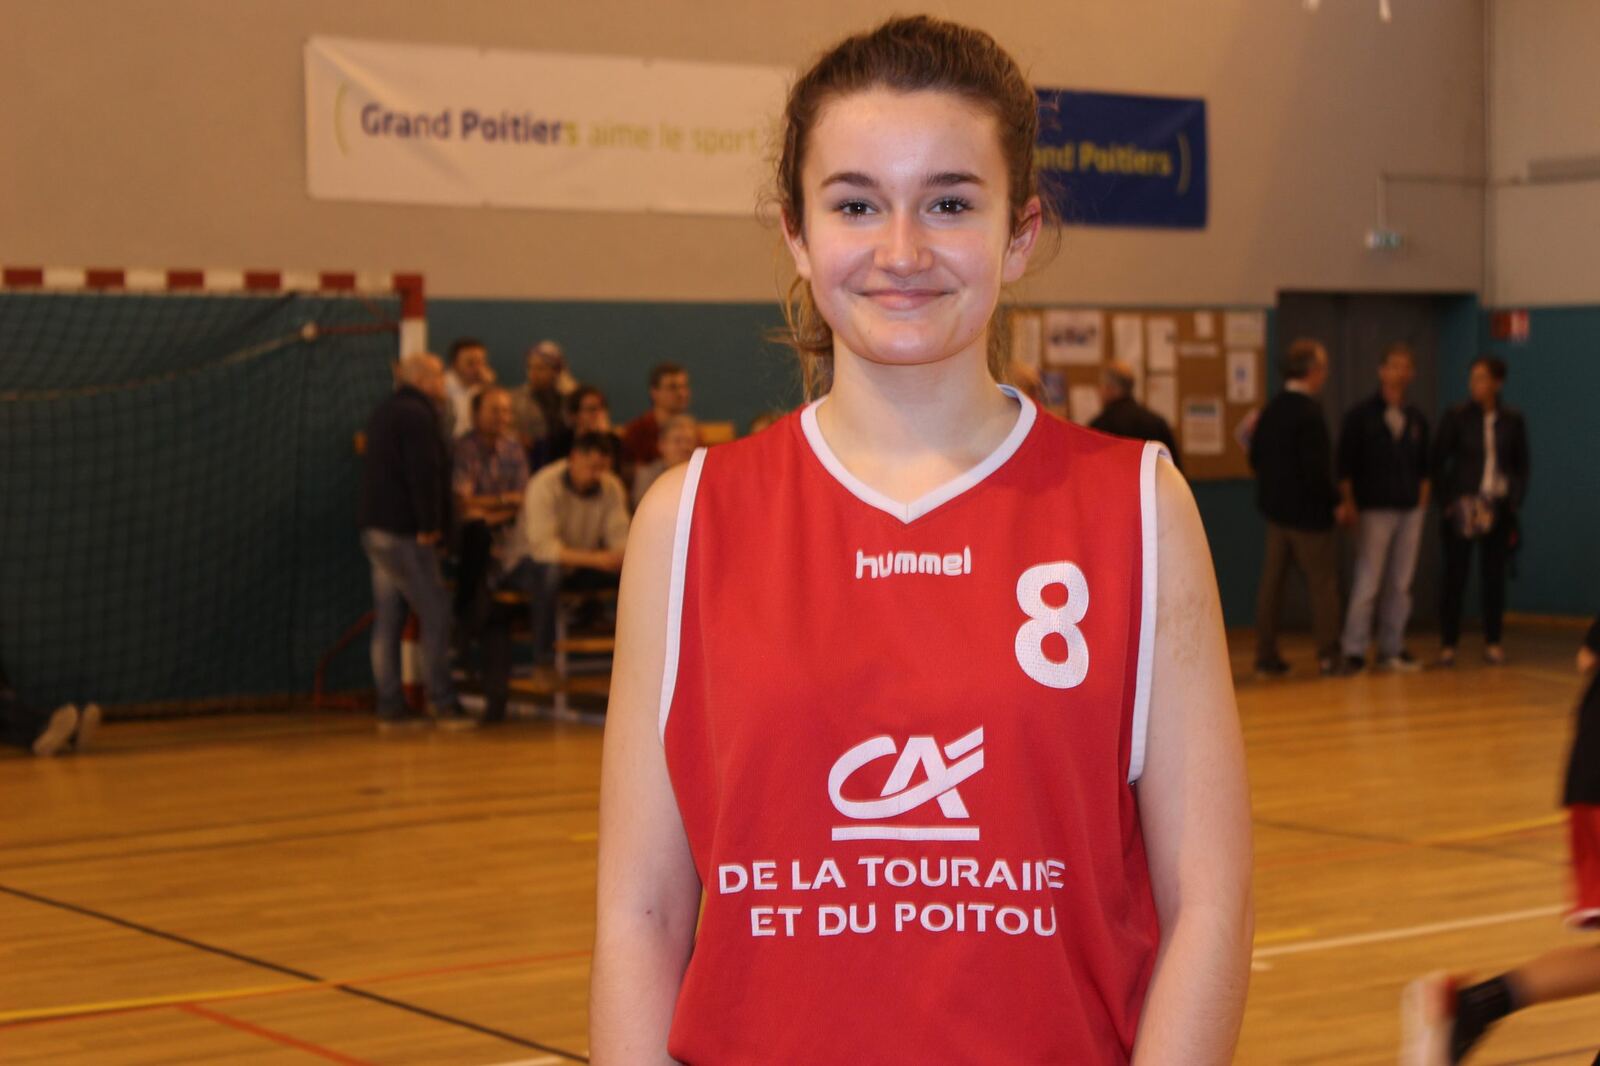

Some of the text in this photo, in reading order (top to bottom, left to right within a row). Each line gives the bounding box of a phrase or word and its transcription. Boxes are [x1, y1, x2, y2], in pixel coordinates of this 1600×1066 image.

[361, 103, 758, 155] Grand Poitiers aime le sport
[1079, 141, 1172, 177] Poitiers
[855, 545, 971, 580] hummel
[1014, 560, 1090, 689] 8
[718, 856, 1066, 894] DE LA TOURAINE
[750, 902, 1057, 937] ET DU POITOU
